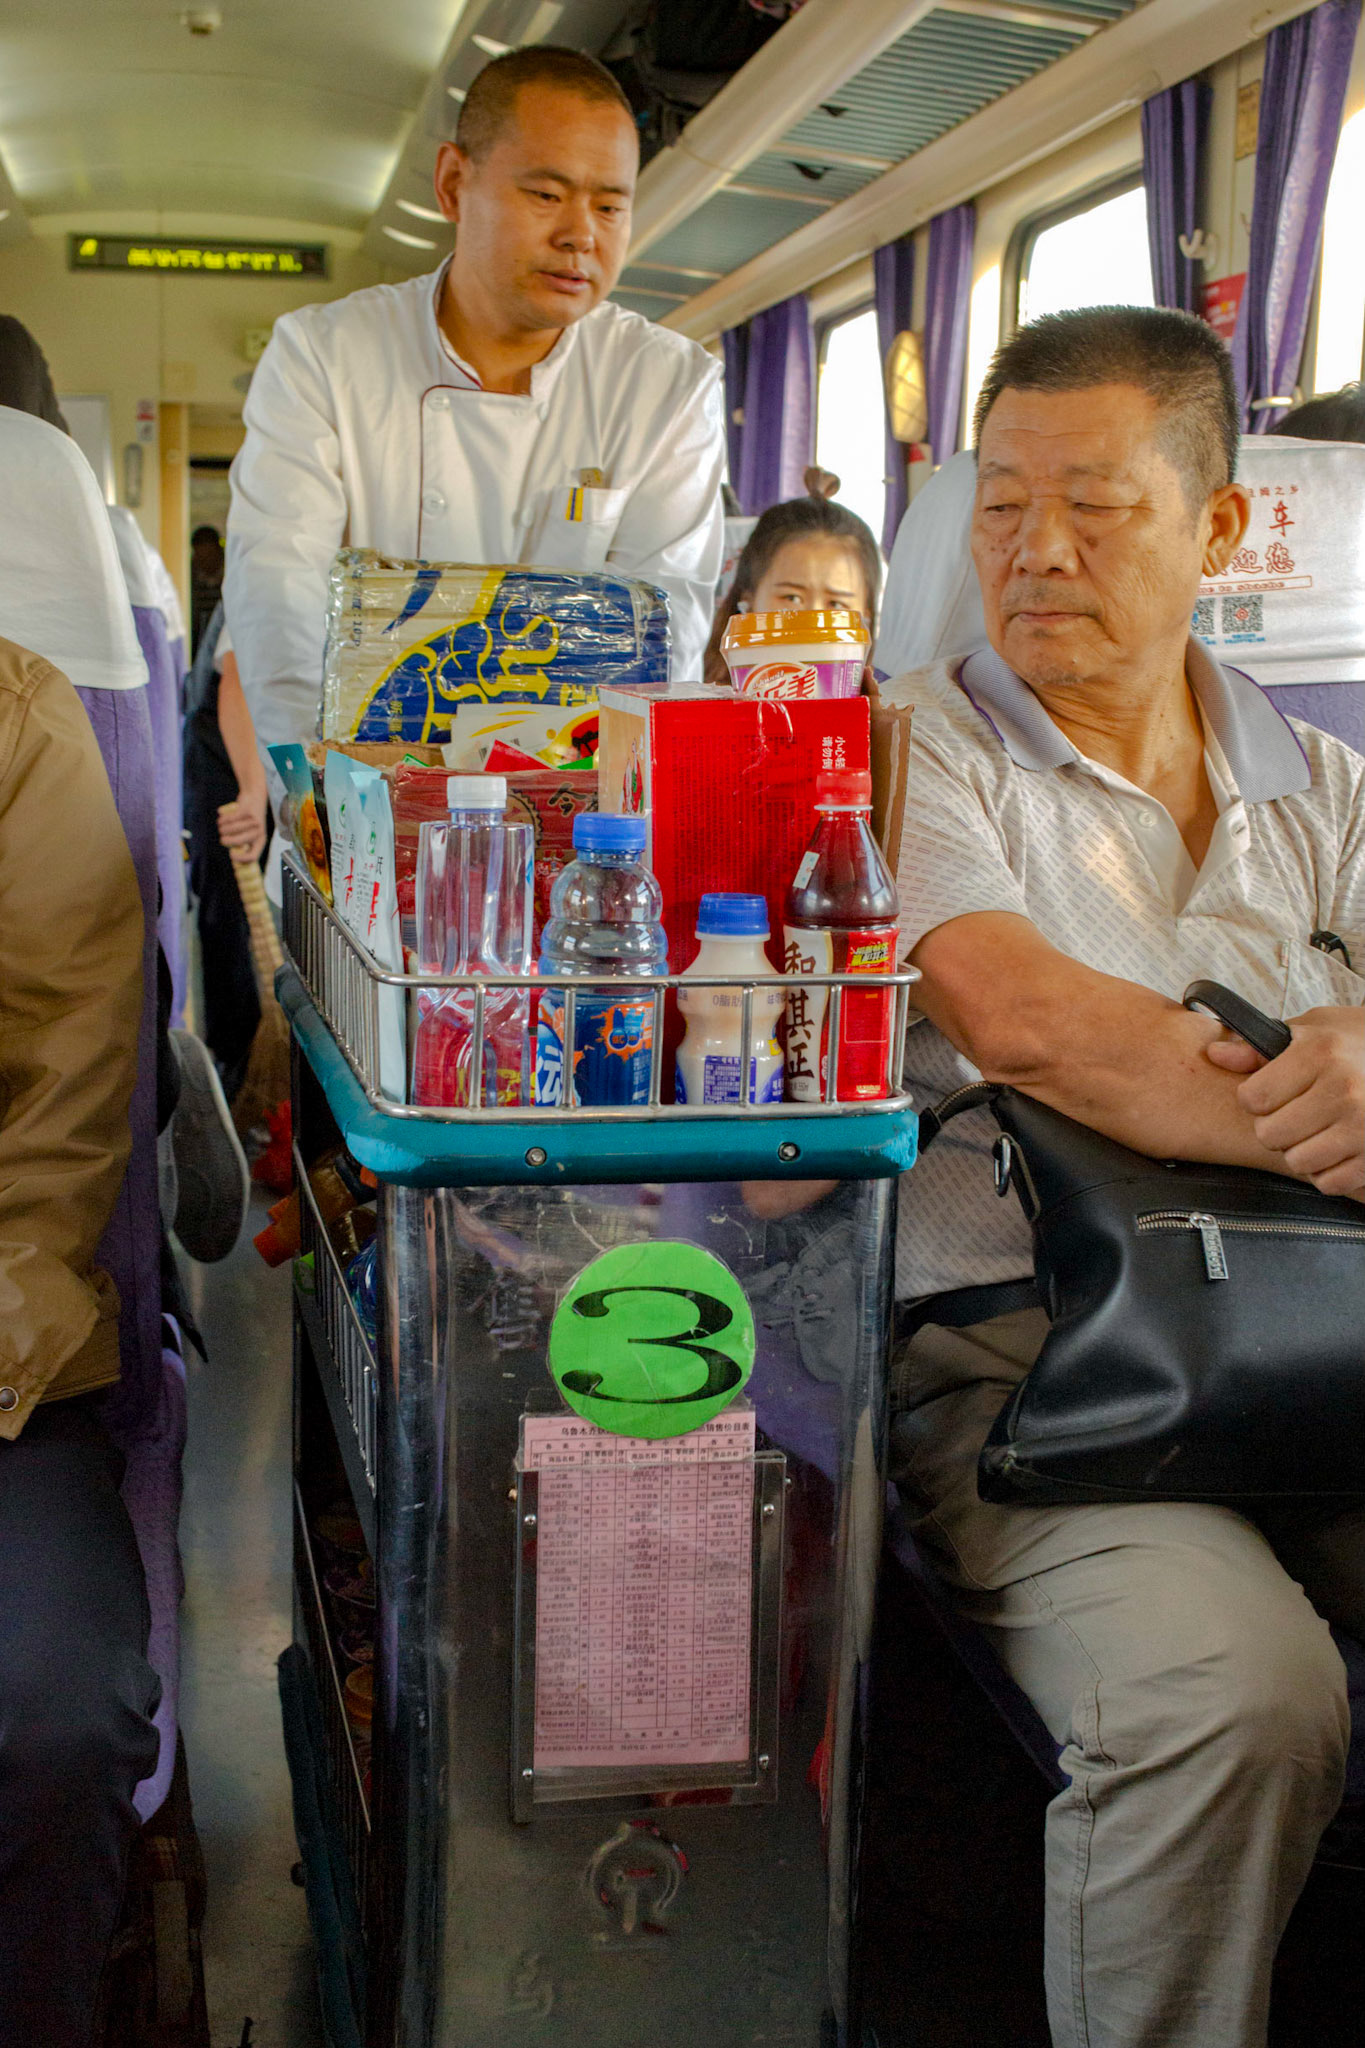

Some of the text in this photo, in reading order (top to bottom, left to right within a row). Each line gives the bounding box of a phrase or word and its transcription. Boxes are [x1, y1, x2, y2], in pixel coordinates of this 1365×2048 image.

[784, 940, 816, 1080] 和其正
[561, 1286, 742, 1404] 3
